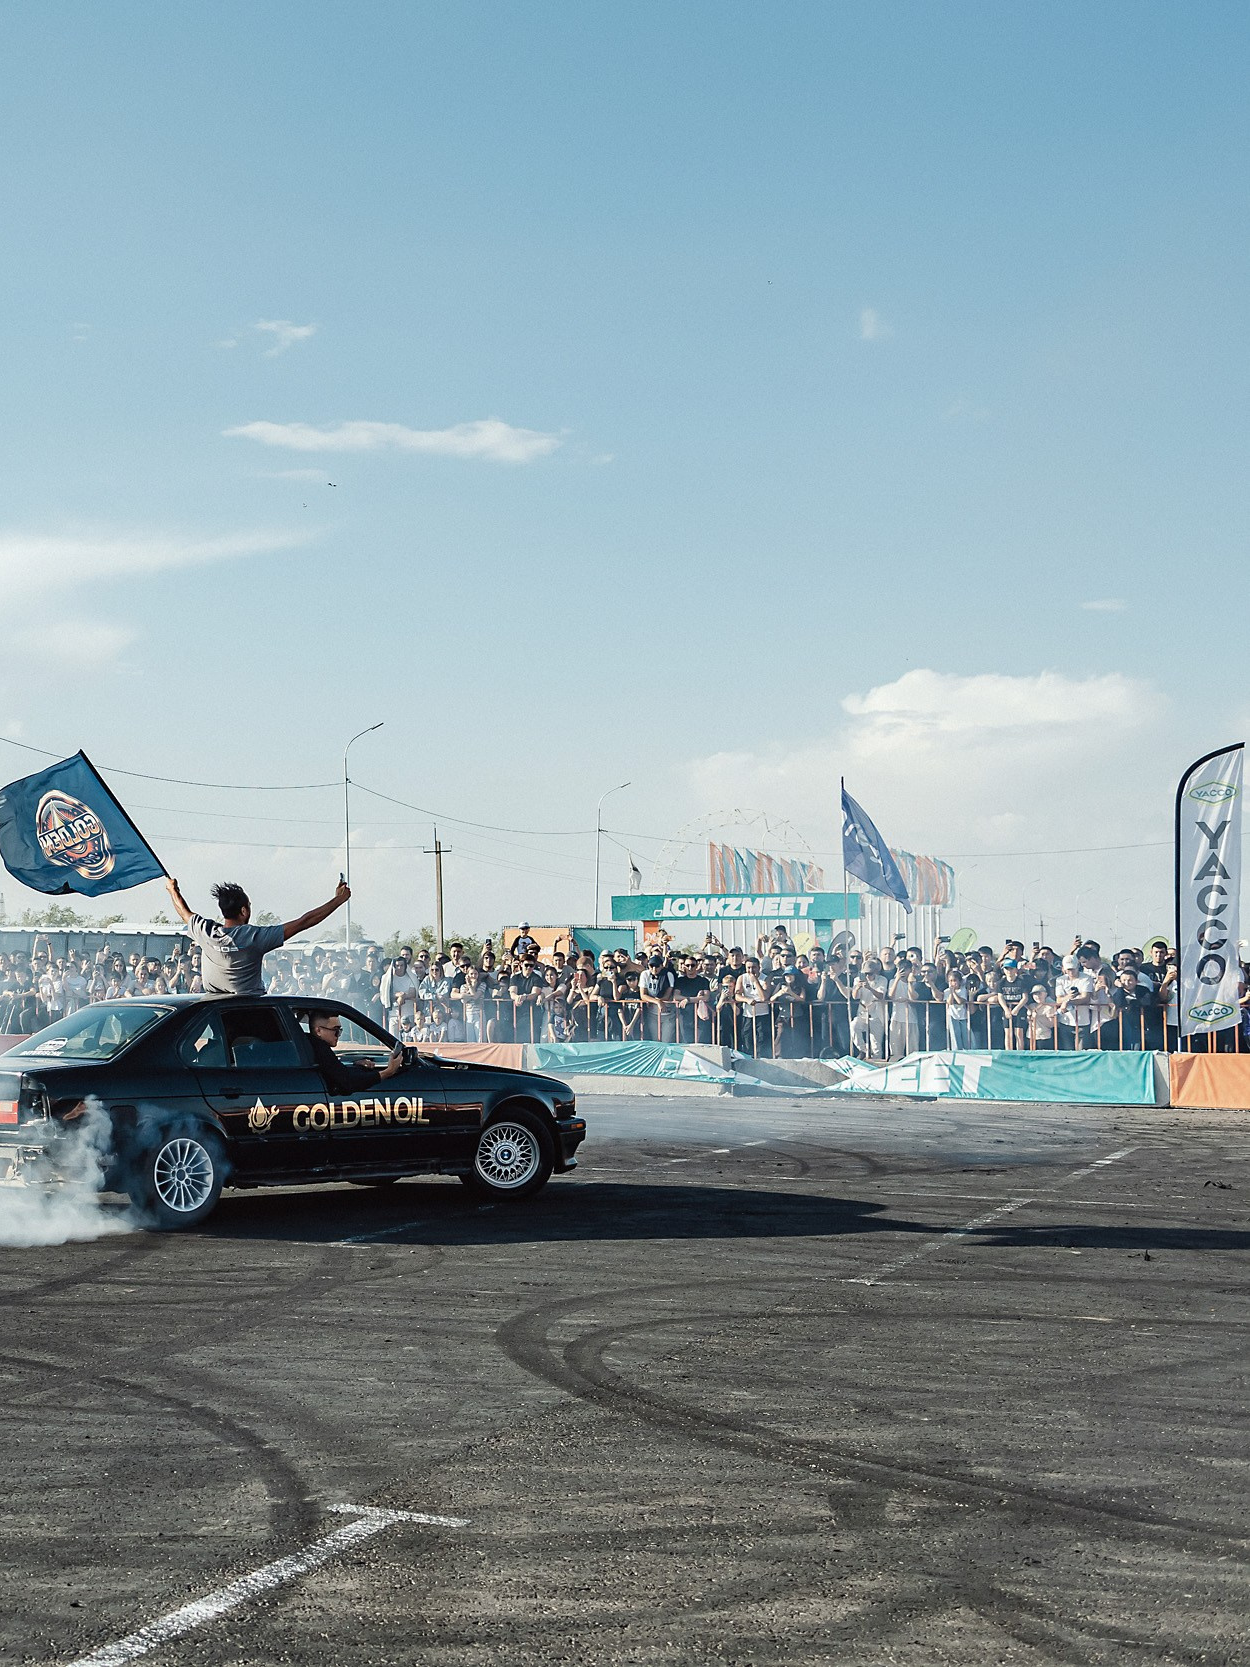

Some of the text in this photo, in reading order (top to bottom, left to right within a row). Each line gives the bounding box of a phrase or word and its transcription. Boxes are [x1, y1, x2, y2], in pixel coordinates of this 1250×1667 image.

[1195, 788, 1233, 798] YACCO
[662, 896, 815, 918] LOWKZMEET
[1193, 820, 1232, 986] YACCO
[1194, 1007, 1229, 1018] YACCO
[292, 1096, 430, 1133] GOLDEN OIL
